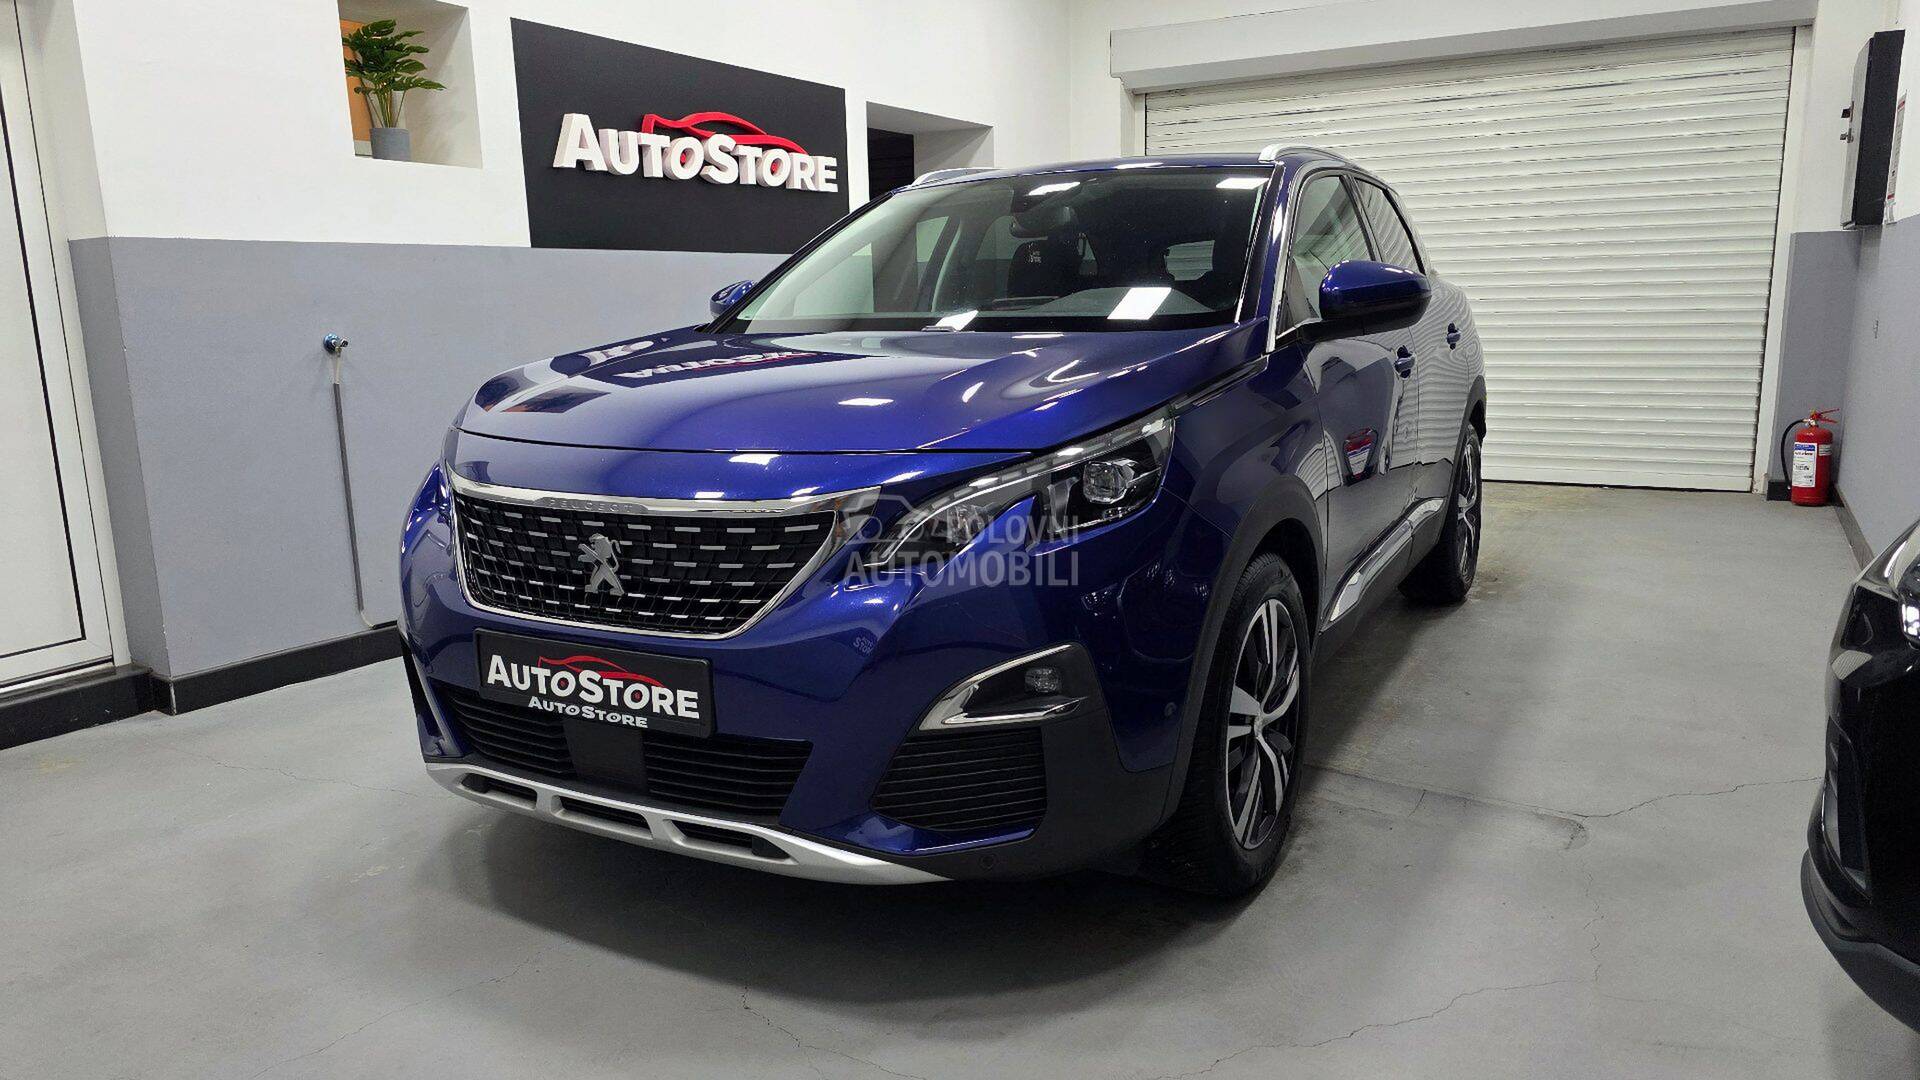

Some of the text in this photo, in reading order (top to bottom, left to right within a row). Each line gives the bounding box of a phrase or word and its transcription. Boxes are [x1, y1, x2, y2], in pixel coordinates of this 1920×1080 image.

[553, 113, 838, 192] AUTOSTORE
[487, 654, 699, 719] AUTOSTORE
[528, 696, 648, 728] AUTOSTORE
